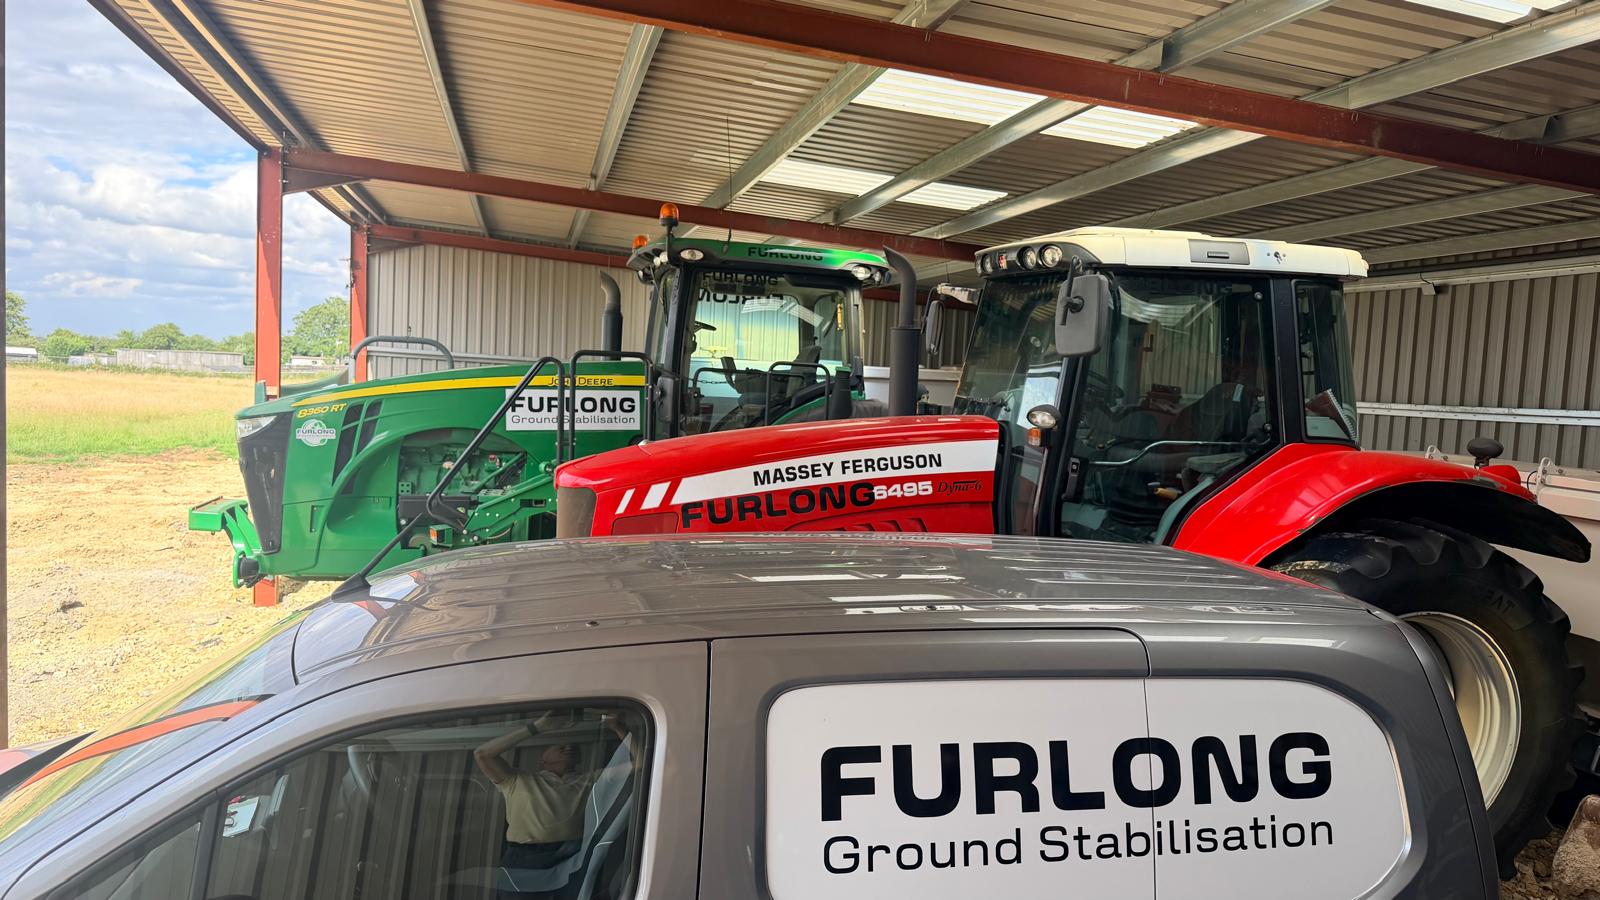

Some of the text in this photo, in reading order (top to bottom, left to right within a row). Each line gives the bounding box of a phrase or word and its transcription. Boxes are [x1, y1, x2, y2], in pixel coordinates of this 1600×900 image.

[578, 377, 613, 385] DEERE
[297, 403, 347, 418] 8360 RT
[563, 414, 636, 424] Sabilisation
[753, 453, 943, 487] MASSEY FERGUSON
[680, 482, 875, 528] FURLONG
[872, 480, 933, 500] 6495
[821, 732, 1332, 821] FURLONG
[823, 814, 1334, 875] Ground Stabilisation
